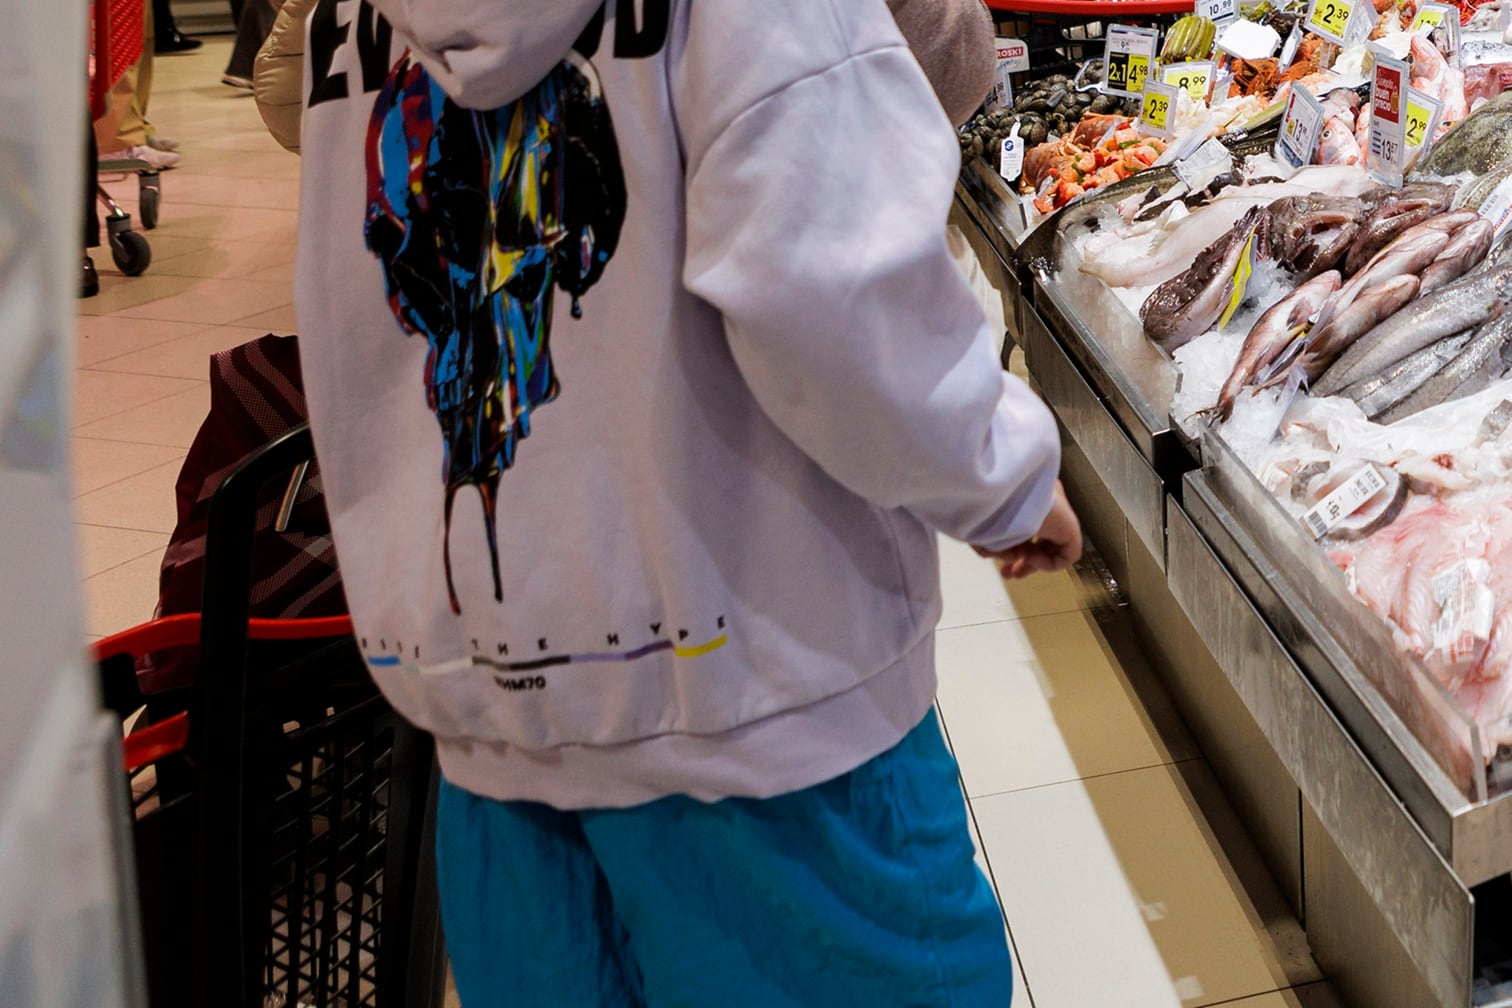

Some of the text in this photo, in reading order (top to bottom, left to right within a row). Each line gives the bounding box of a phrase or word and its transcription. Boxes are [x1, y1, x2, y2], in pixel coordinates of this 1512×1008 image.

[1323, 3, 1350, 24] 2,39
[997, 46, 1022, 59] ROSKI
[1108, 62, 1126, 83] 2x1
